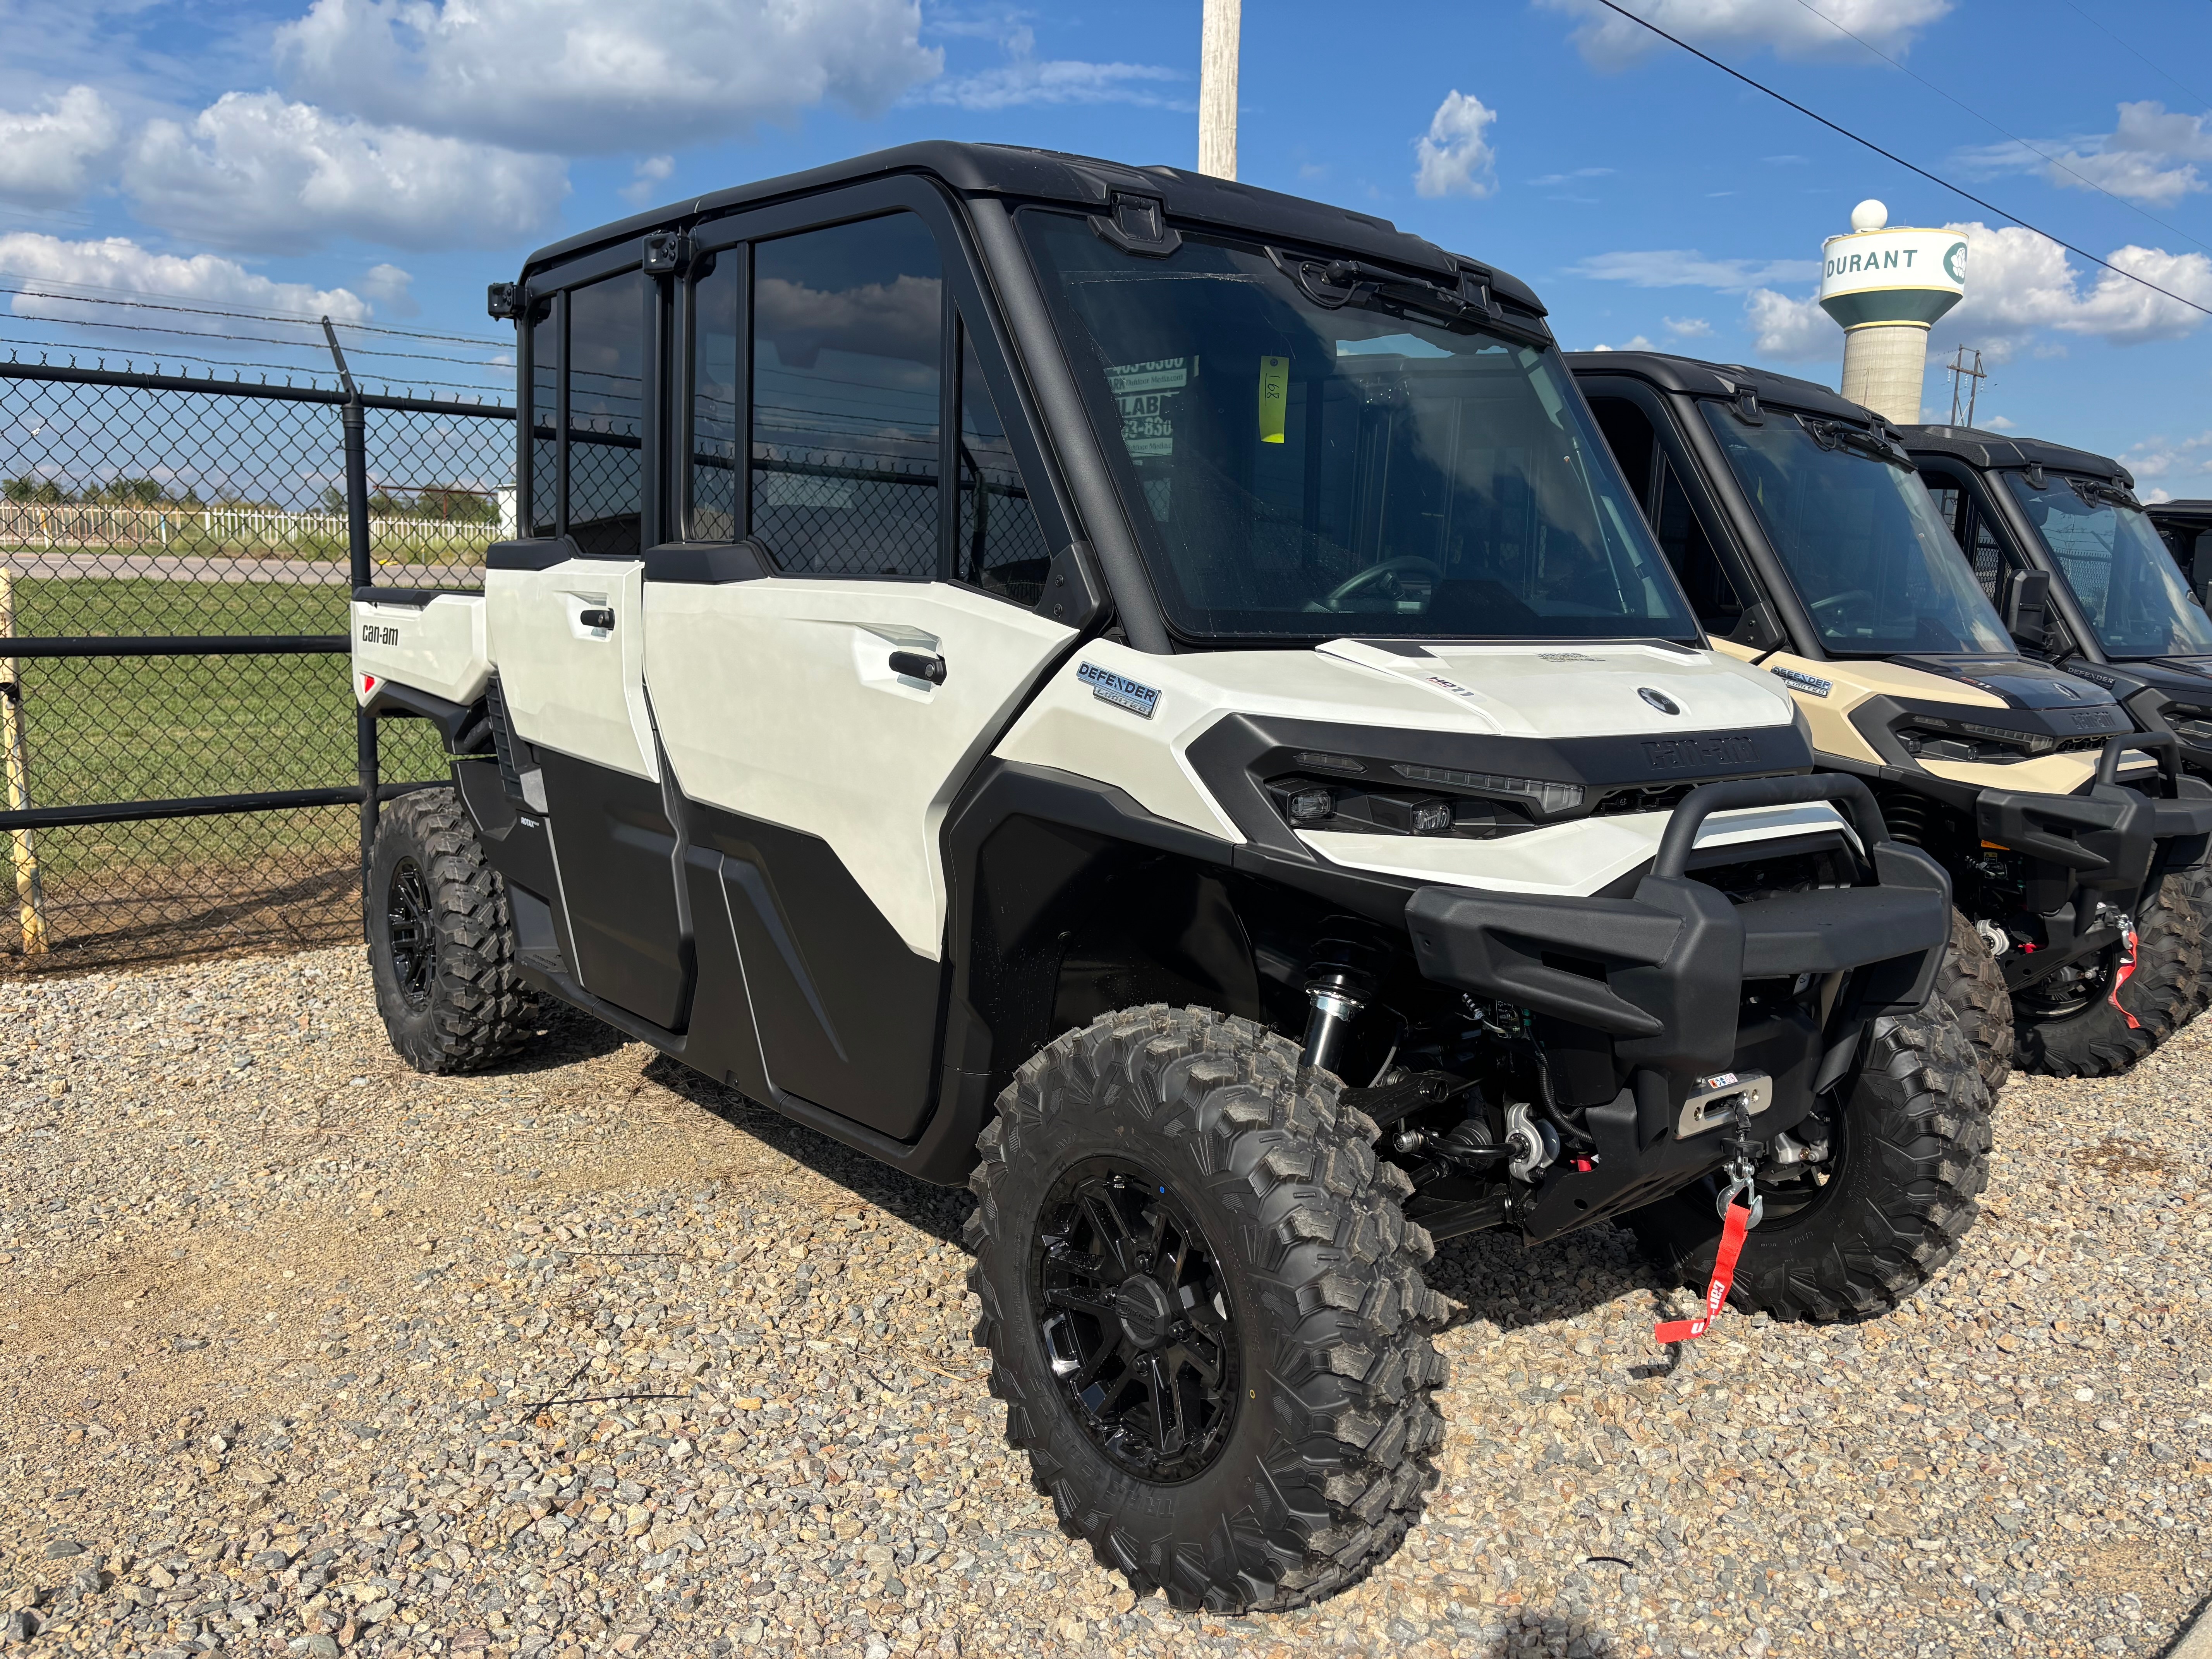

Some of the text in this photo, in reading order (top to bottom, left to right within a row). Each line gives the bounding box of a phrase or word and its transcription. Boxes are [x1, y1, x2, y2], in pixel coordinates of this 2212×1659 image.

[1826, 249, 1918, 278] DURANT
[1119, 396, 1159, 416] LAB
[362, 624, 398, 646] can-am
[1079, 663, 1156, 702] DEFENDER
[1772, 666, 1831, 689] DEFENDER
[2068, 667, 2114, 684] DEFENDER
